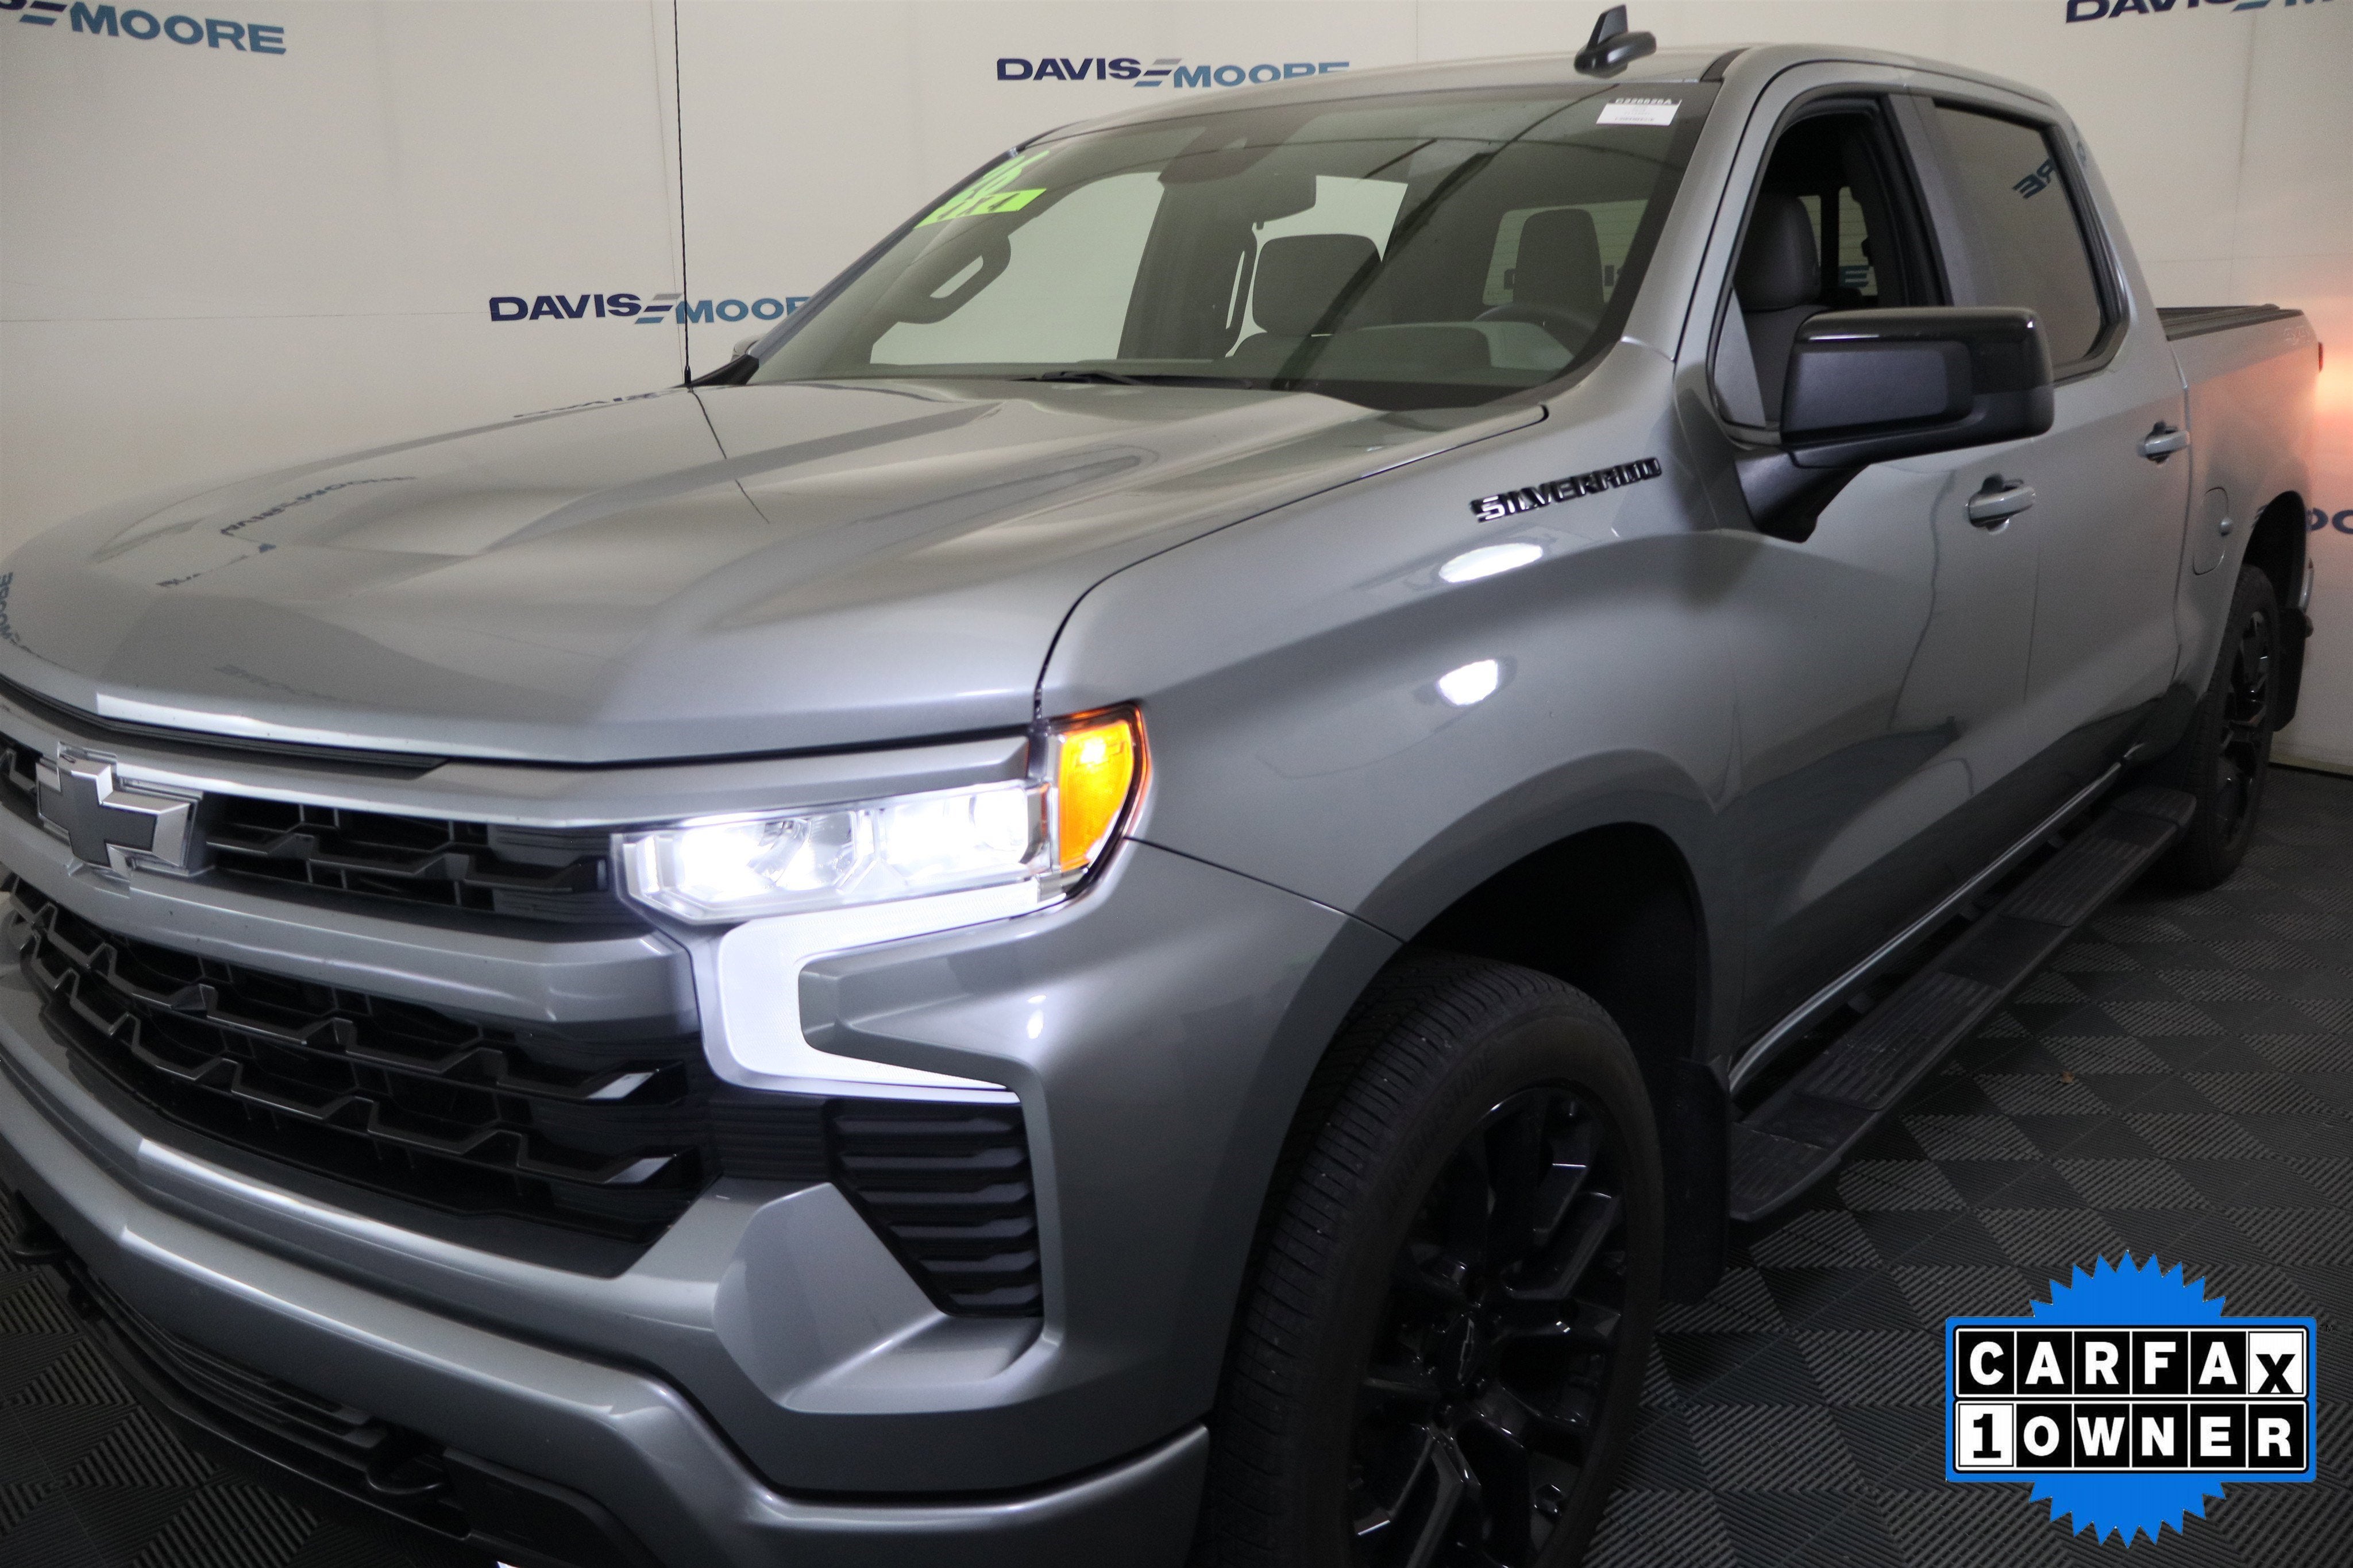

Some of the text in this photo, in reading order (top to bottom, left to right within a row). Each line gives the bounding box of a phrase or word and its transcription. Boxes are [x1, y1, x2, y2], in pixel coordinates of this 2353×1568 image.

[70, 1, 287, 55] MOORE
[997, 58, 1141, 80] DAVIS
[489, 293, 642, 322] DAVIS
[1468, 457, 1662, 524] SILVERADO
